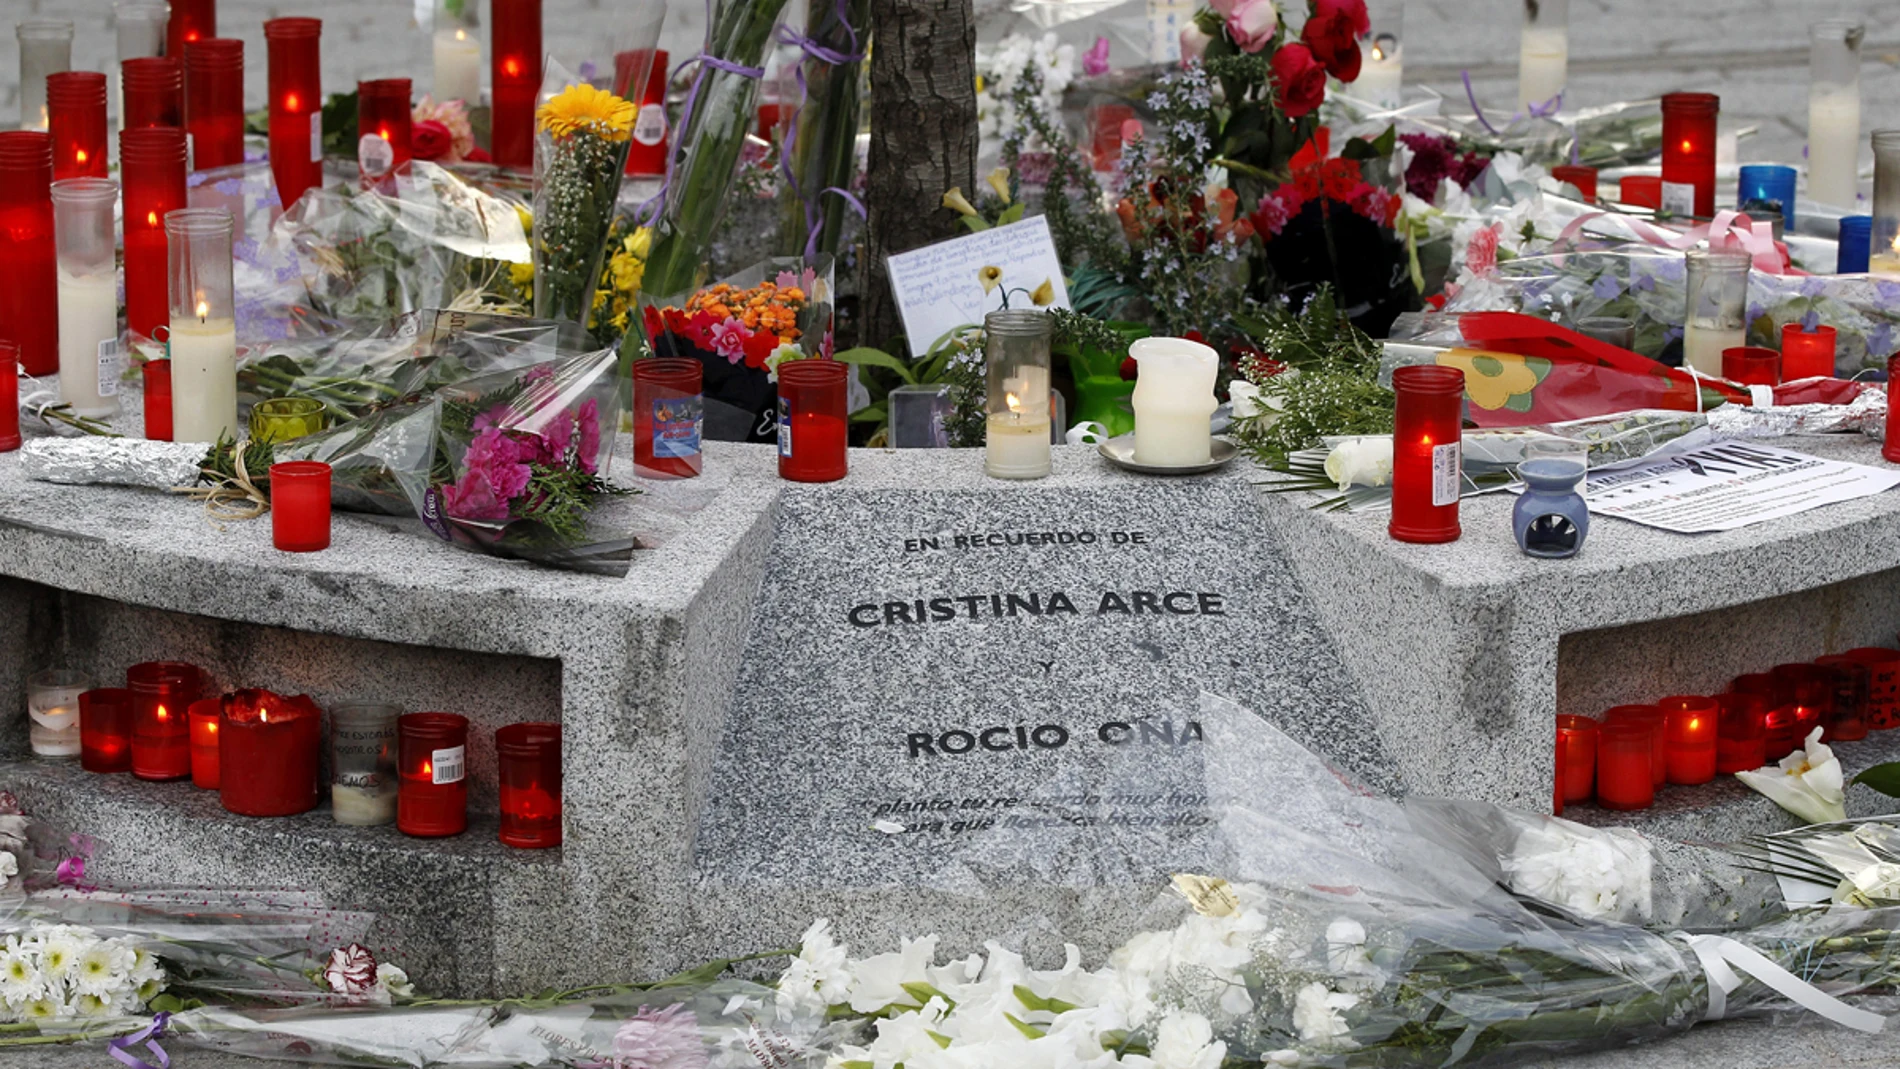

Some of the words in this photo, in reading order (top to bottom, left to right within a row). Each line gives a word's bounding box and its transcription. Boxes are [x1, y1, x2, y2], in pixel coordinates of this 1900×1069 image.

[904, 538, 939, 551] EN
[954, 532, 1097, 549] RECUERDO
[1111, 531, 1146, 545] DE
[850, 591, 1080, 628] CRISTINA
[1097, 591, 1226, 615] ARCE
[1038, 661, 1053, 673] Y
[886, 819, 943, 837] ara
[950, 818, 995, 836] que
